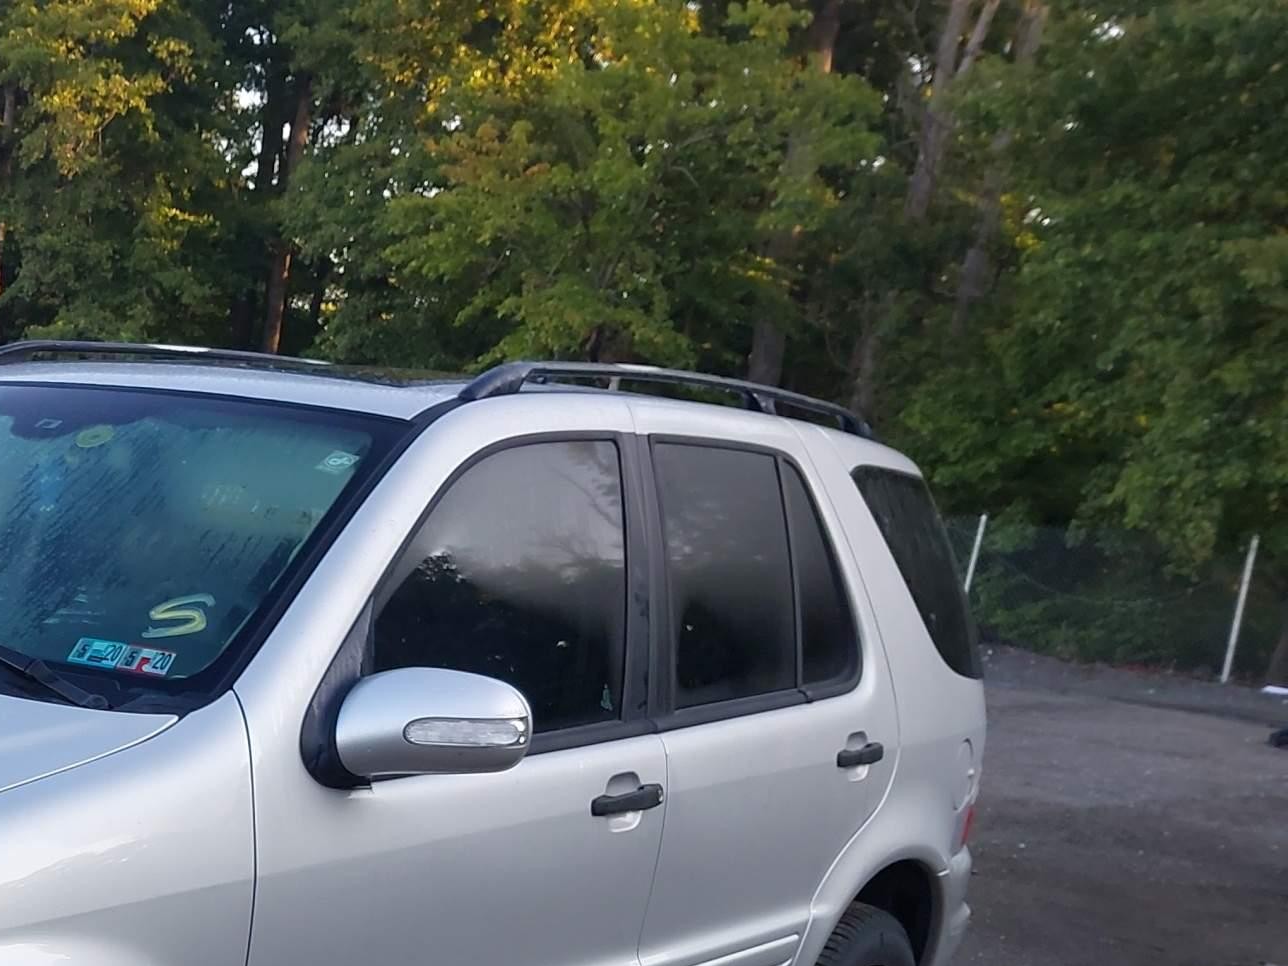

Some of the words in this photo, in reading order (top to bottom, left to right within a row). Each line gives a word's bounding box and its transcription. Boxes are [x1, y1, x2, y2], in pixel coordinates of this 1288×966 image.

[104, 644, 122, 661] 20
[124, 651, 137, 666] 5
[151, 652, 172, 670] 20
